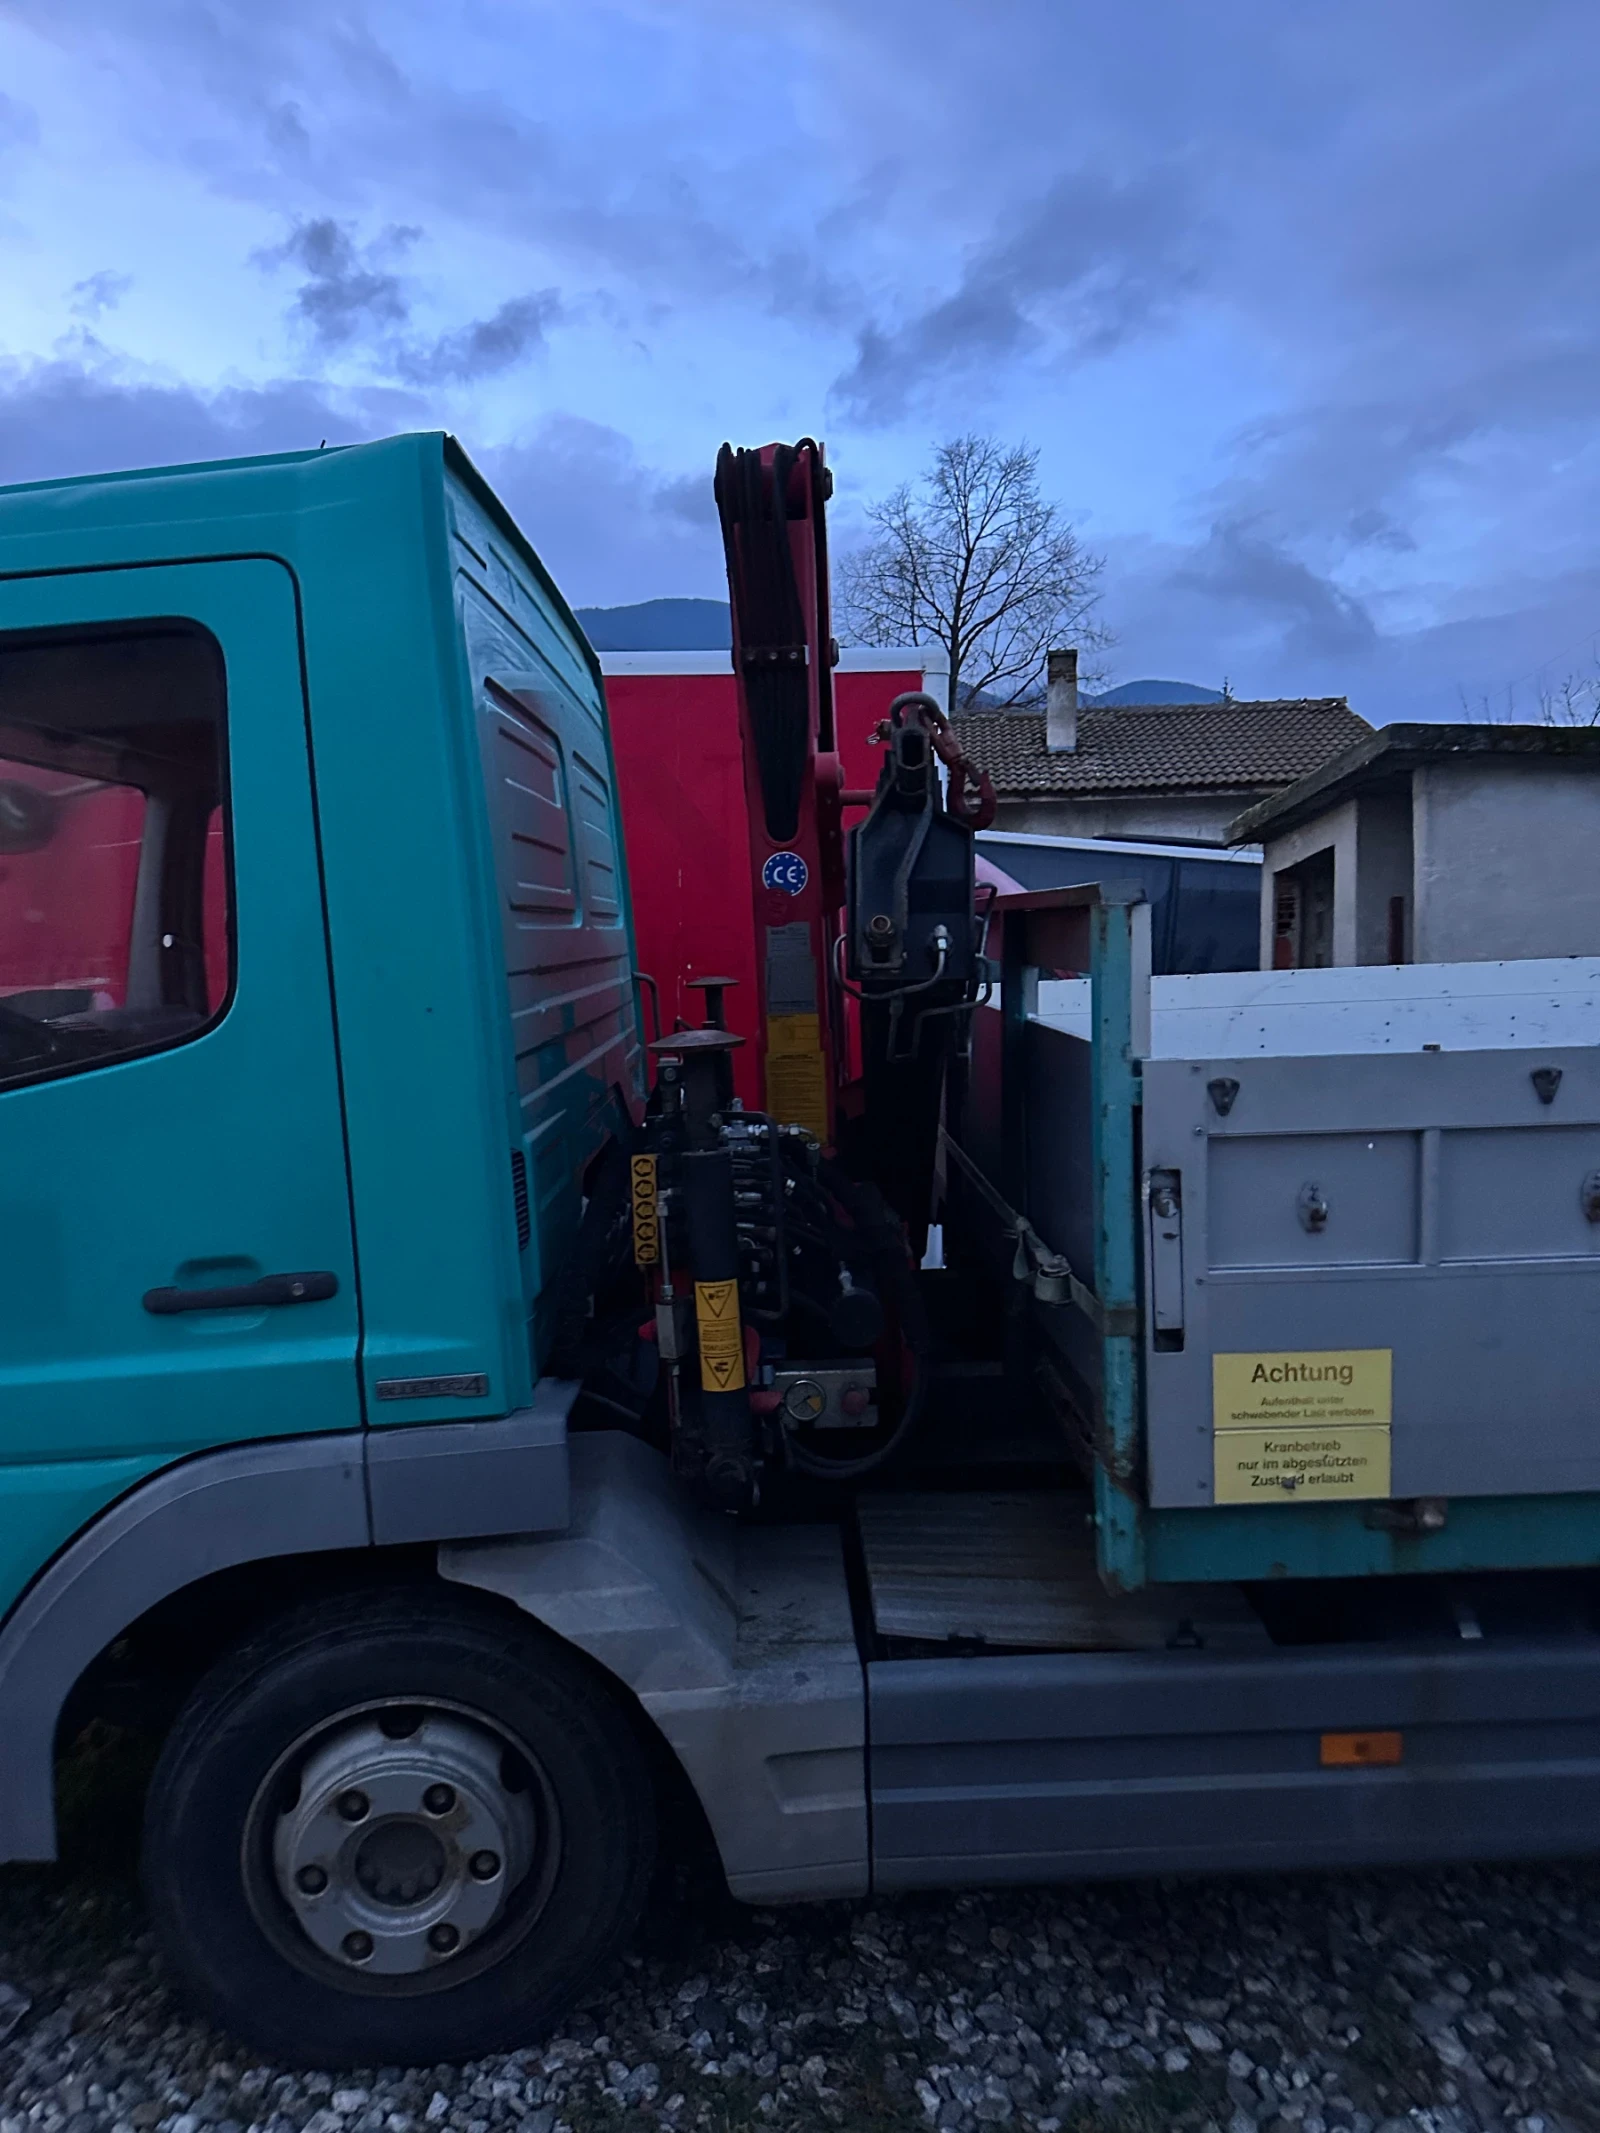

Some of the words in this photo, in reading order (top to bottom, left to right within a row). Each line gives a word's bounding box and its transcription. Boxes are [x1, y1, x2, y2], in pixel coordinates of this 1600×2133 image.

[773, 866, 797, 883] CE
[1251, 1362, 1353, 1385] Achtung
[1231, 1410, 1300, 1420] schwebender
[1264, 1440, 1341, 1453] Kranbetrieb
[1238, 1460, 1259, 1471] nur
[1263, 1459, 1279, 1469] im
[1308, 1472, 1354, 1484] erlaubt
